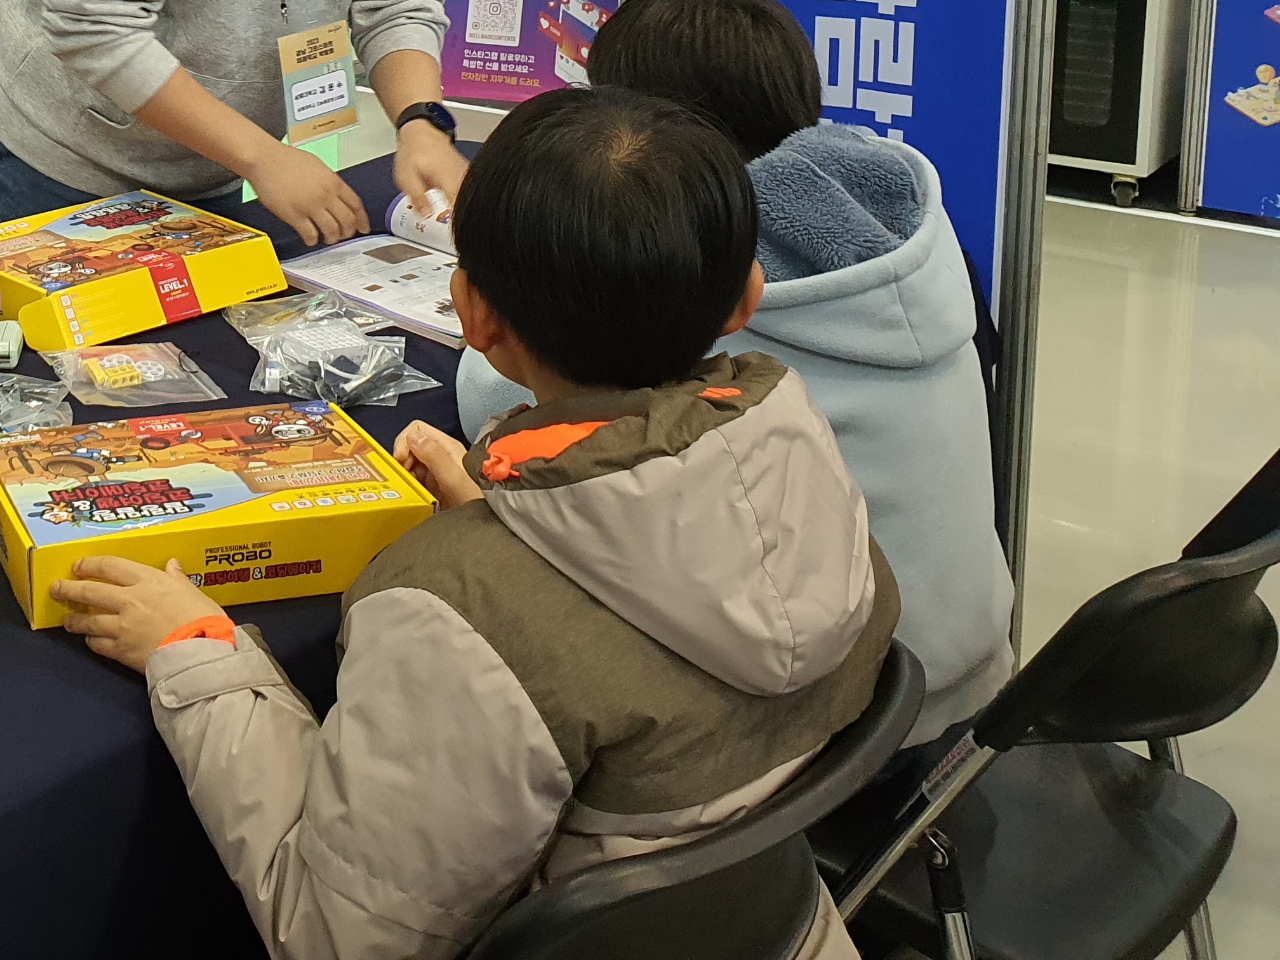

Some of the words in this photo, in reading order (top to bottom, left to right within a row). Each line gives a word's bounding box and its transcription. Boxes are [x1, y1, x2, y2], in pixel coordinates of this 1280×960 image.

[464, 49, 498, 60] 인스타그램
[500, 52, 535, 63] 팔로우하고
[463, 59, 484, 69] 특별한
[486, 62, 499, 71] 선물
[159, 277, 189, 293] LEVEL.1
[49, 479, 171, 502] 코딩메이커
[91, 502, 191, 522] 말랑말랑
[205, 543, 250, 555] PROFESSIONAL
[251, 541, 272, 550] ROBOT
[205, 549, 272, 566] PROBO
